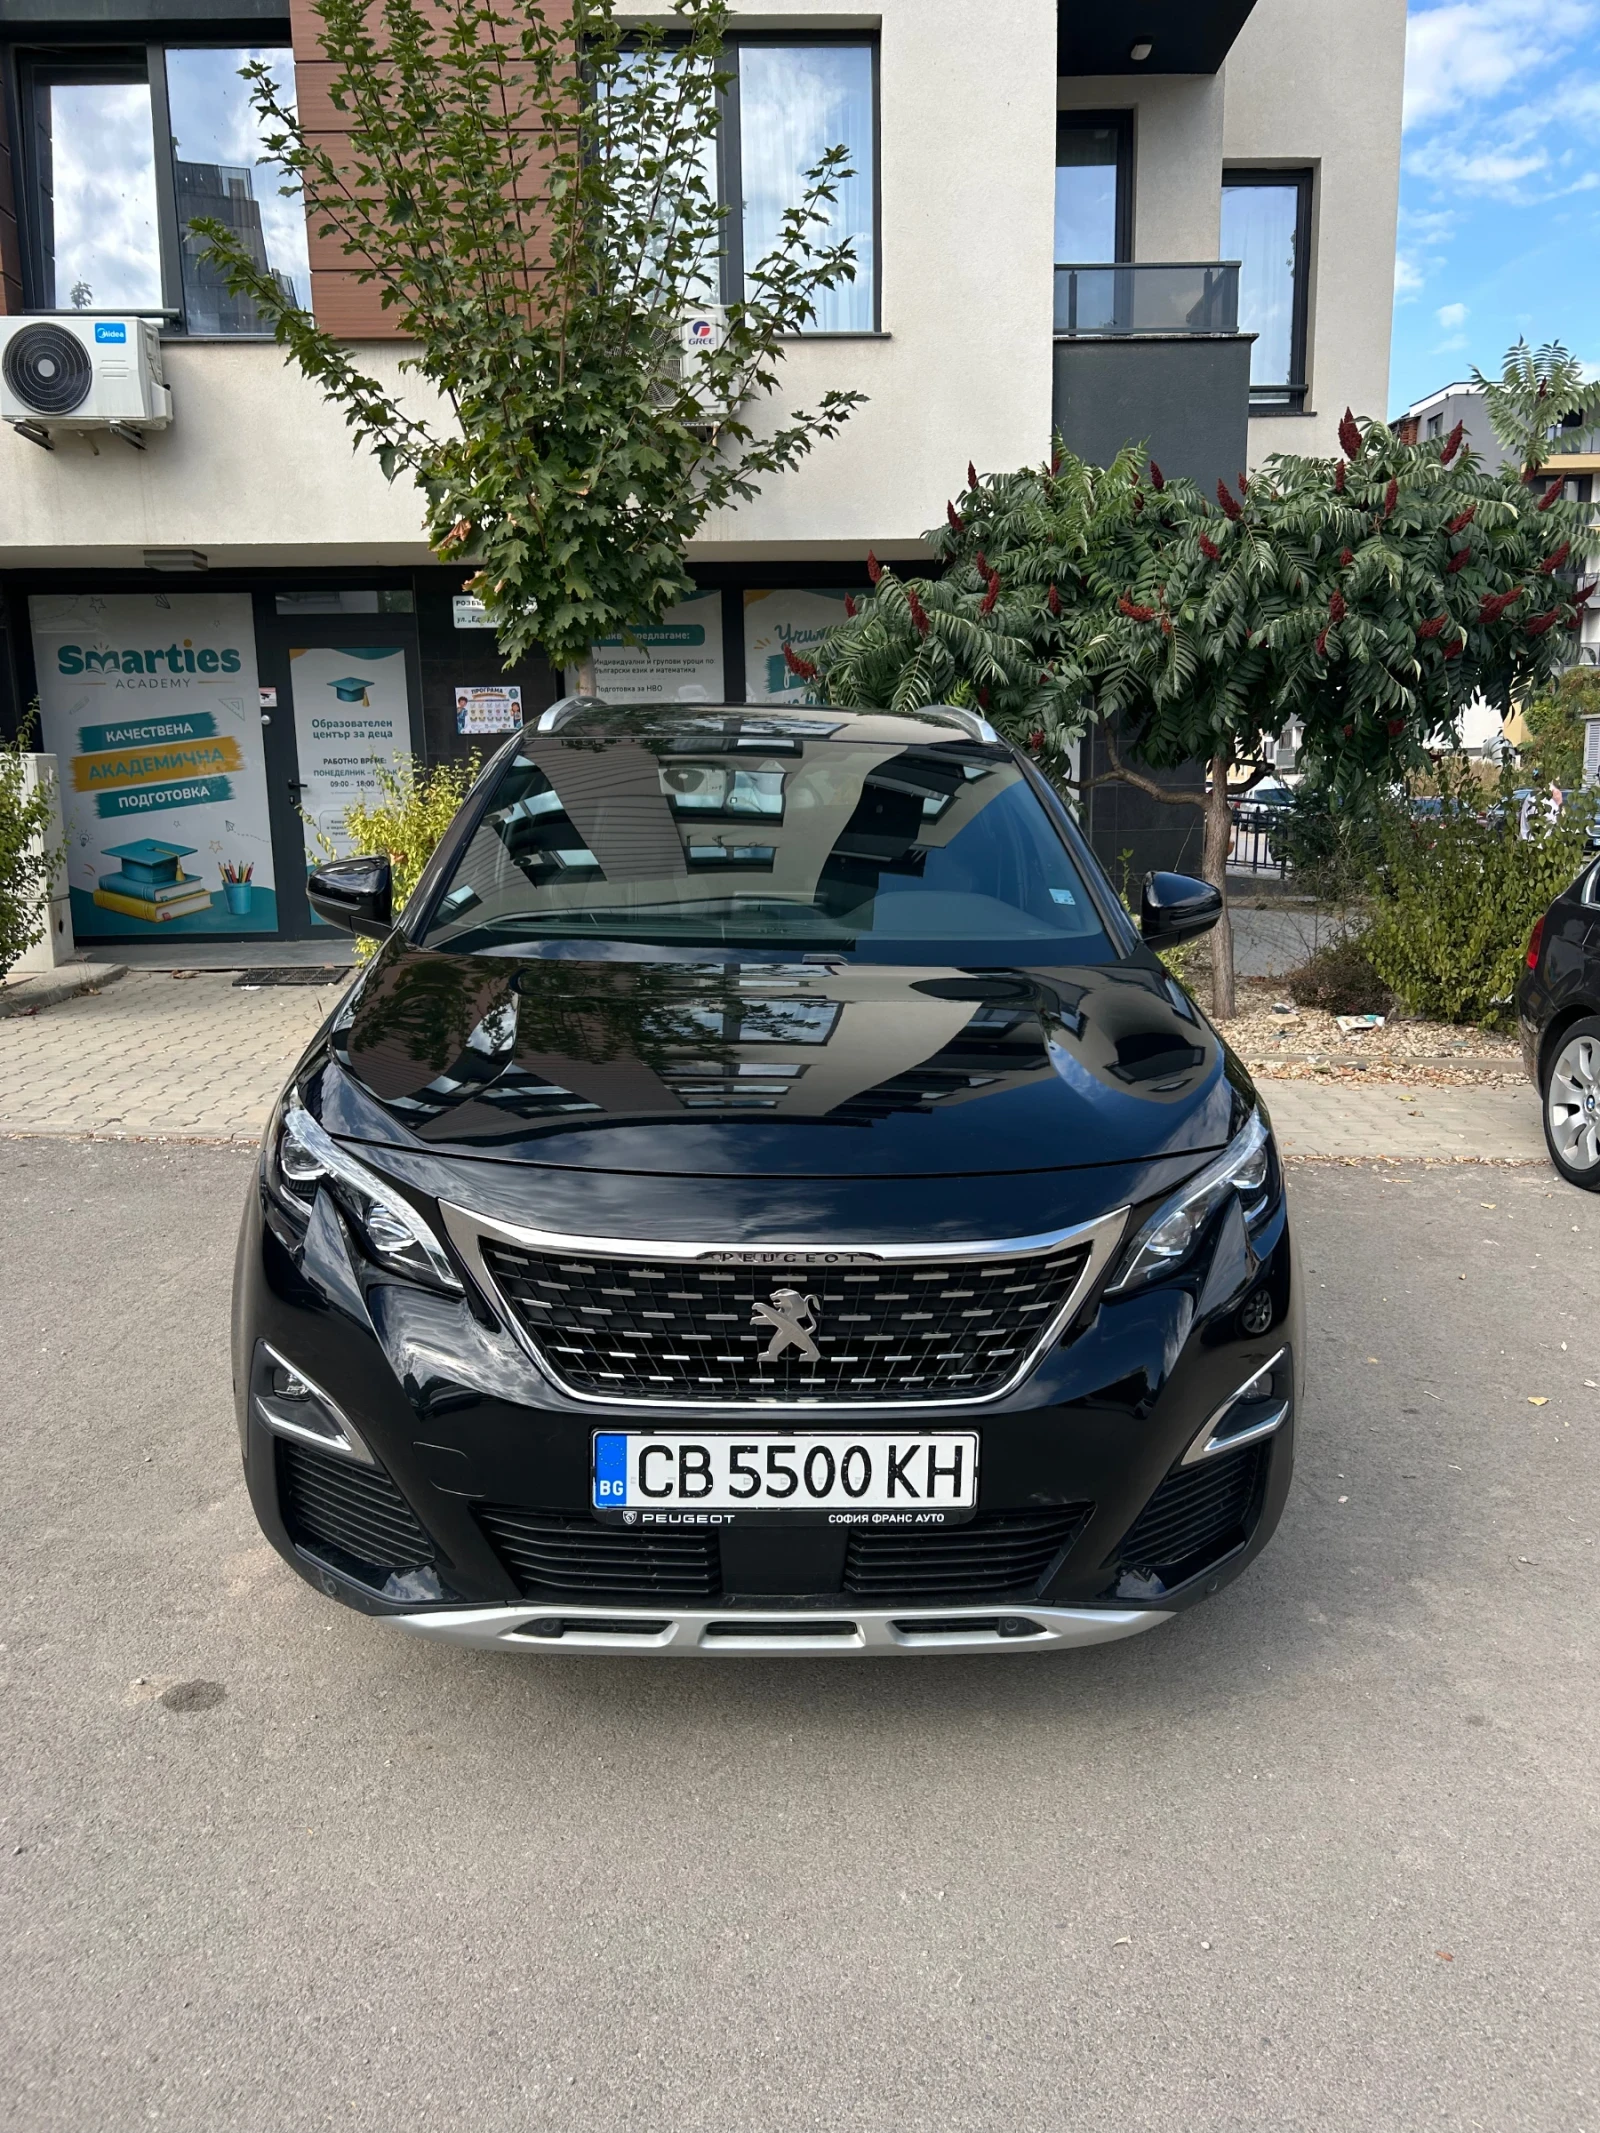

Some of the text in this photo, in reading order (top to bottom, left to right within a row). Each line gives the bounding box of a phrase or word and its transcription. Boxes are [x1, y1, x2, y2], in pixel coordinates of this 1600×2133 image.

[99, 329, 125, 338] Midea
[635, 632, 690, 641] редлагаме:
[57, 638, 241, 675] Smarties
[594, 659, 645, 667] Индивидуални
[653, 659, 681, 667] групови
[115, 678, 191, 689] ACADEMY
[646, 684, 663, 692] НВО
[311, 719, 393, 730] Образователен
[105, 722, 194, 743] КАЧЕСТВЕНА
[313, 731, 351, 740] център
[368, 730, 393, 739] деца
[88, 747, 225, 781] АКАДЕМИЧНА
[313, 769, 366, 777] ПОНЕДЕЛНИК
[118, 785, 211, 809] ПОДГОТОВКА
[721, 1252, 860, 1263] PEUGEOT
[599, 1480, 624, 1497] BG
[642, 1514, 735, 1524] PEUGEOT
[828, 1512, 945, 1524] СОФИЯ ФРАНС АУТО
